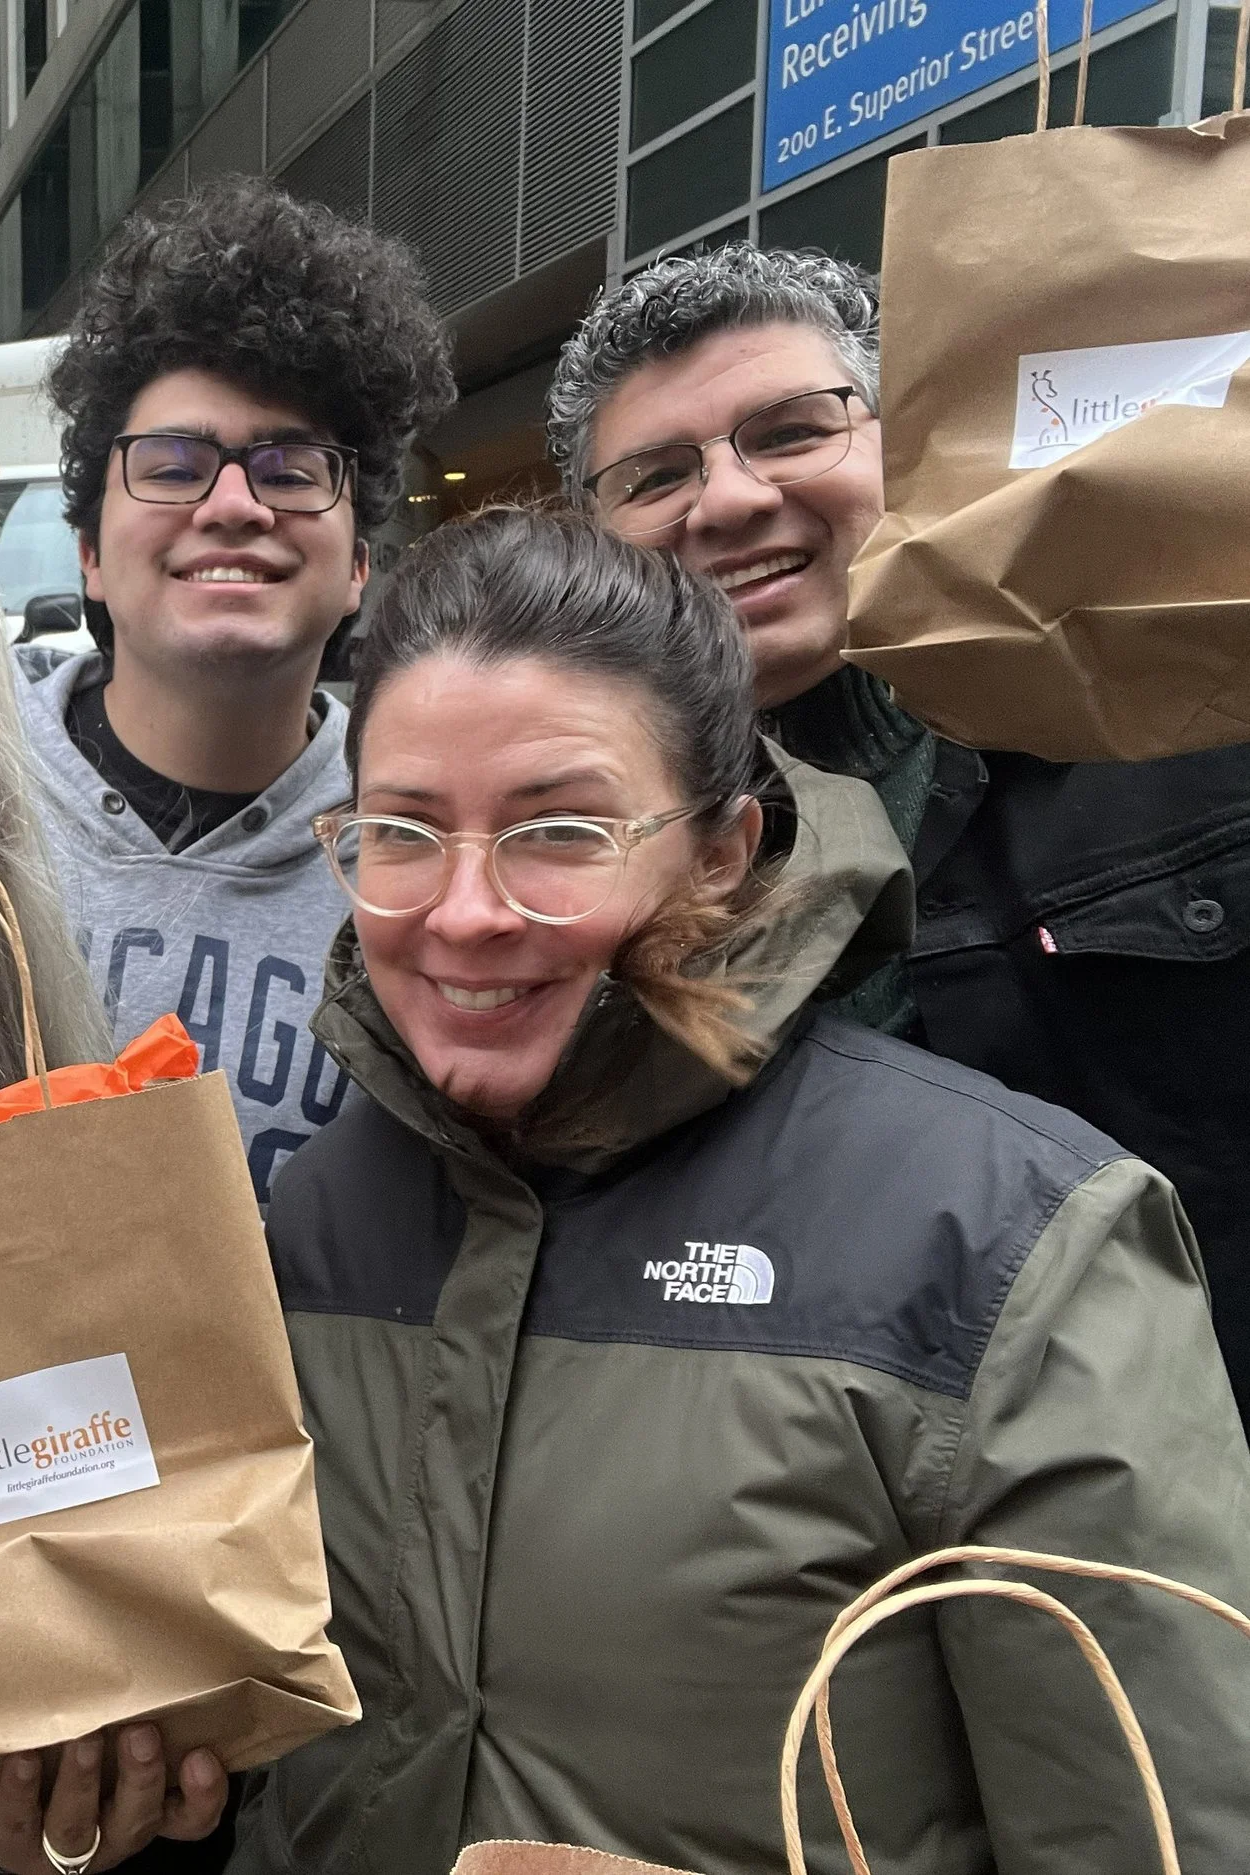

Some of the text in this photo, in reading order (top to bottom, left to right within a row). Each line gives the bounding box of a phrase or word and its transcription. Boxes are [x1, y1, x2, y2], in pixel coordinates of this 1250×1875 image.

[777, 8, 1040, 164] 200 E. Superior Stree
[684, 1241, 738, 1264] THE
[643, 1260, 734, 1283] NORTH
[663, 1281, 730, 1303] FACE
[53, 1438, 134, 1466] FOUNDATION
[7, 1459, 115, 1493] littlegiraffefoundation.org
